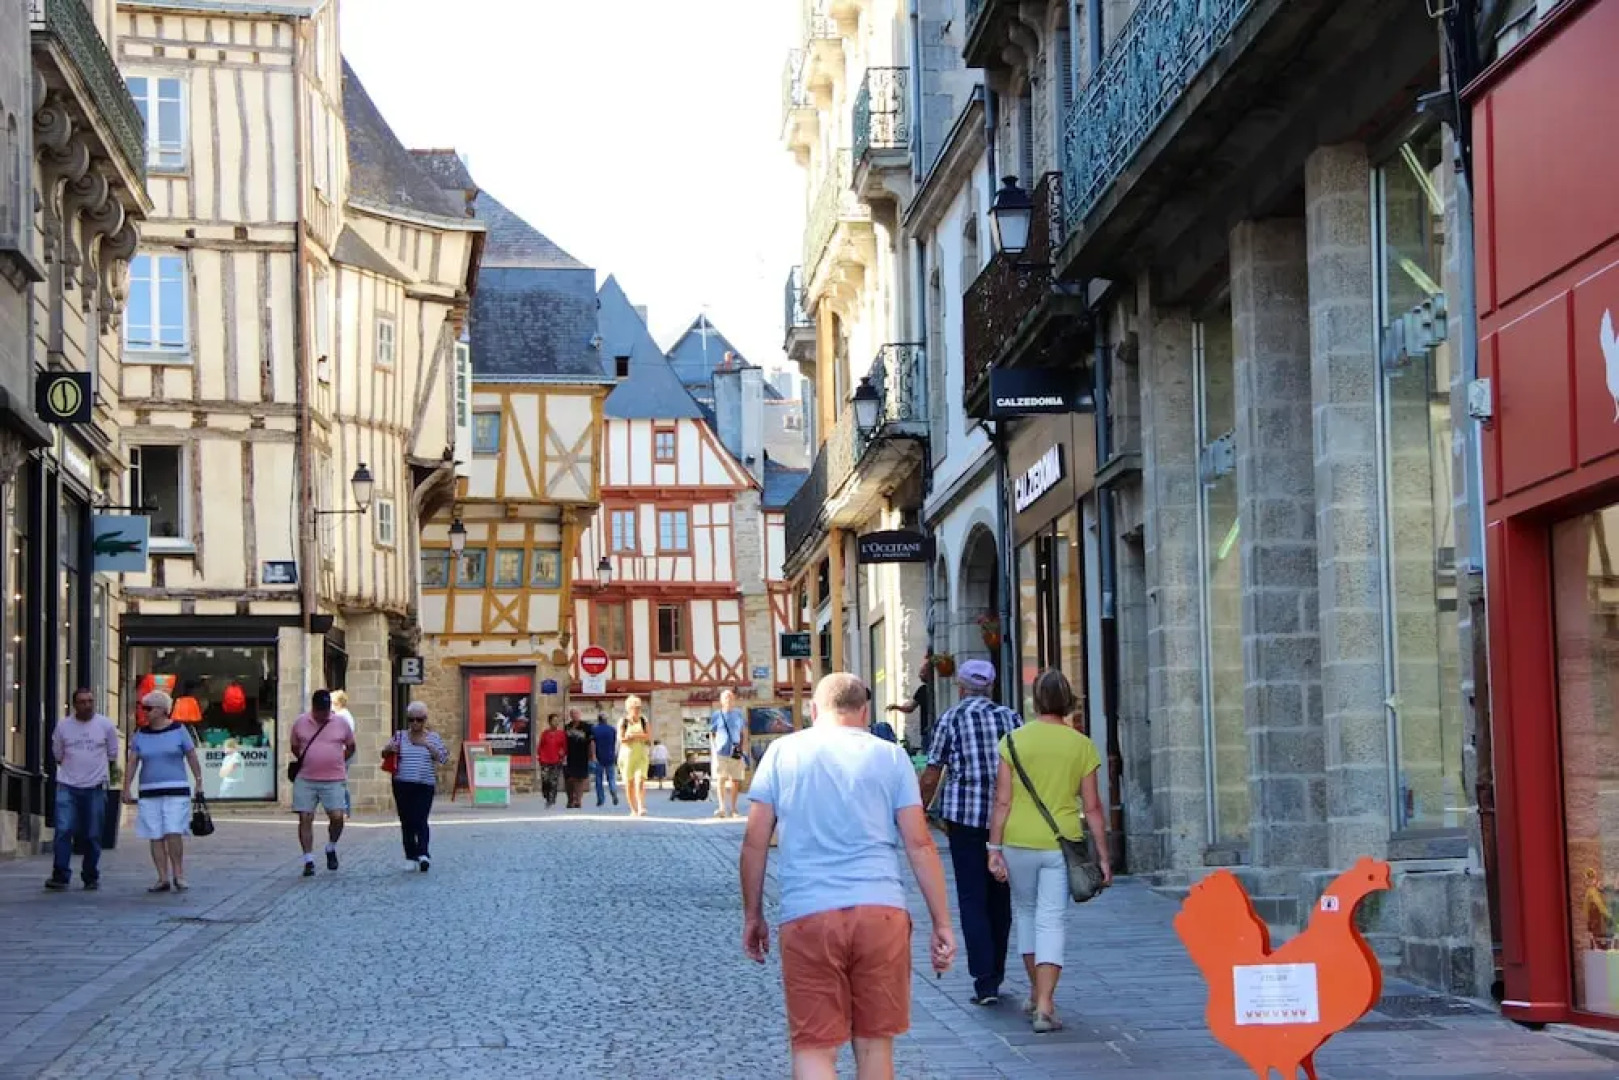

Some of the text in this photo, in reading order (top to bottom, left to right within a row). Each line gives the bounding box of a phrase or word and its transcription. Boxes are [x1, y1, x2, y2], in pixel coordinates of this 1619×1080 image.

[996, 396, 1064, 407] CALZEDONIA
[862, 543, 920, 553] L'OCCITANE
[401, 658, 420, 676] B
